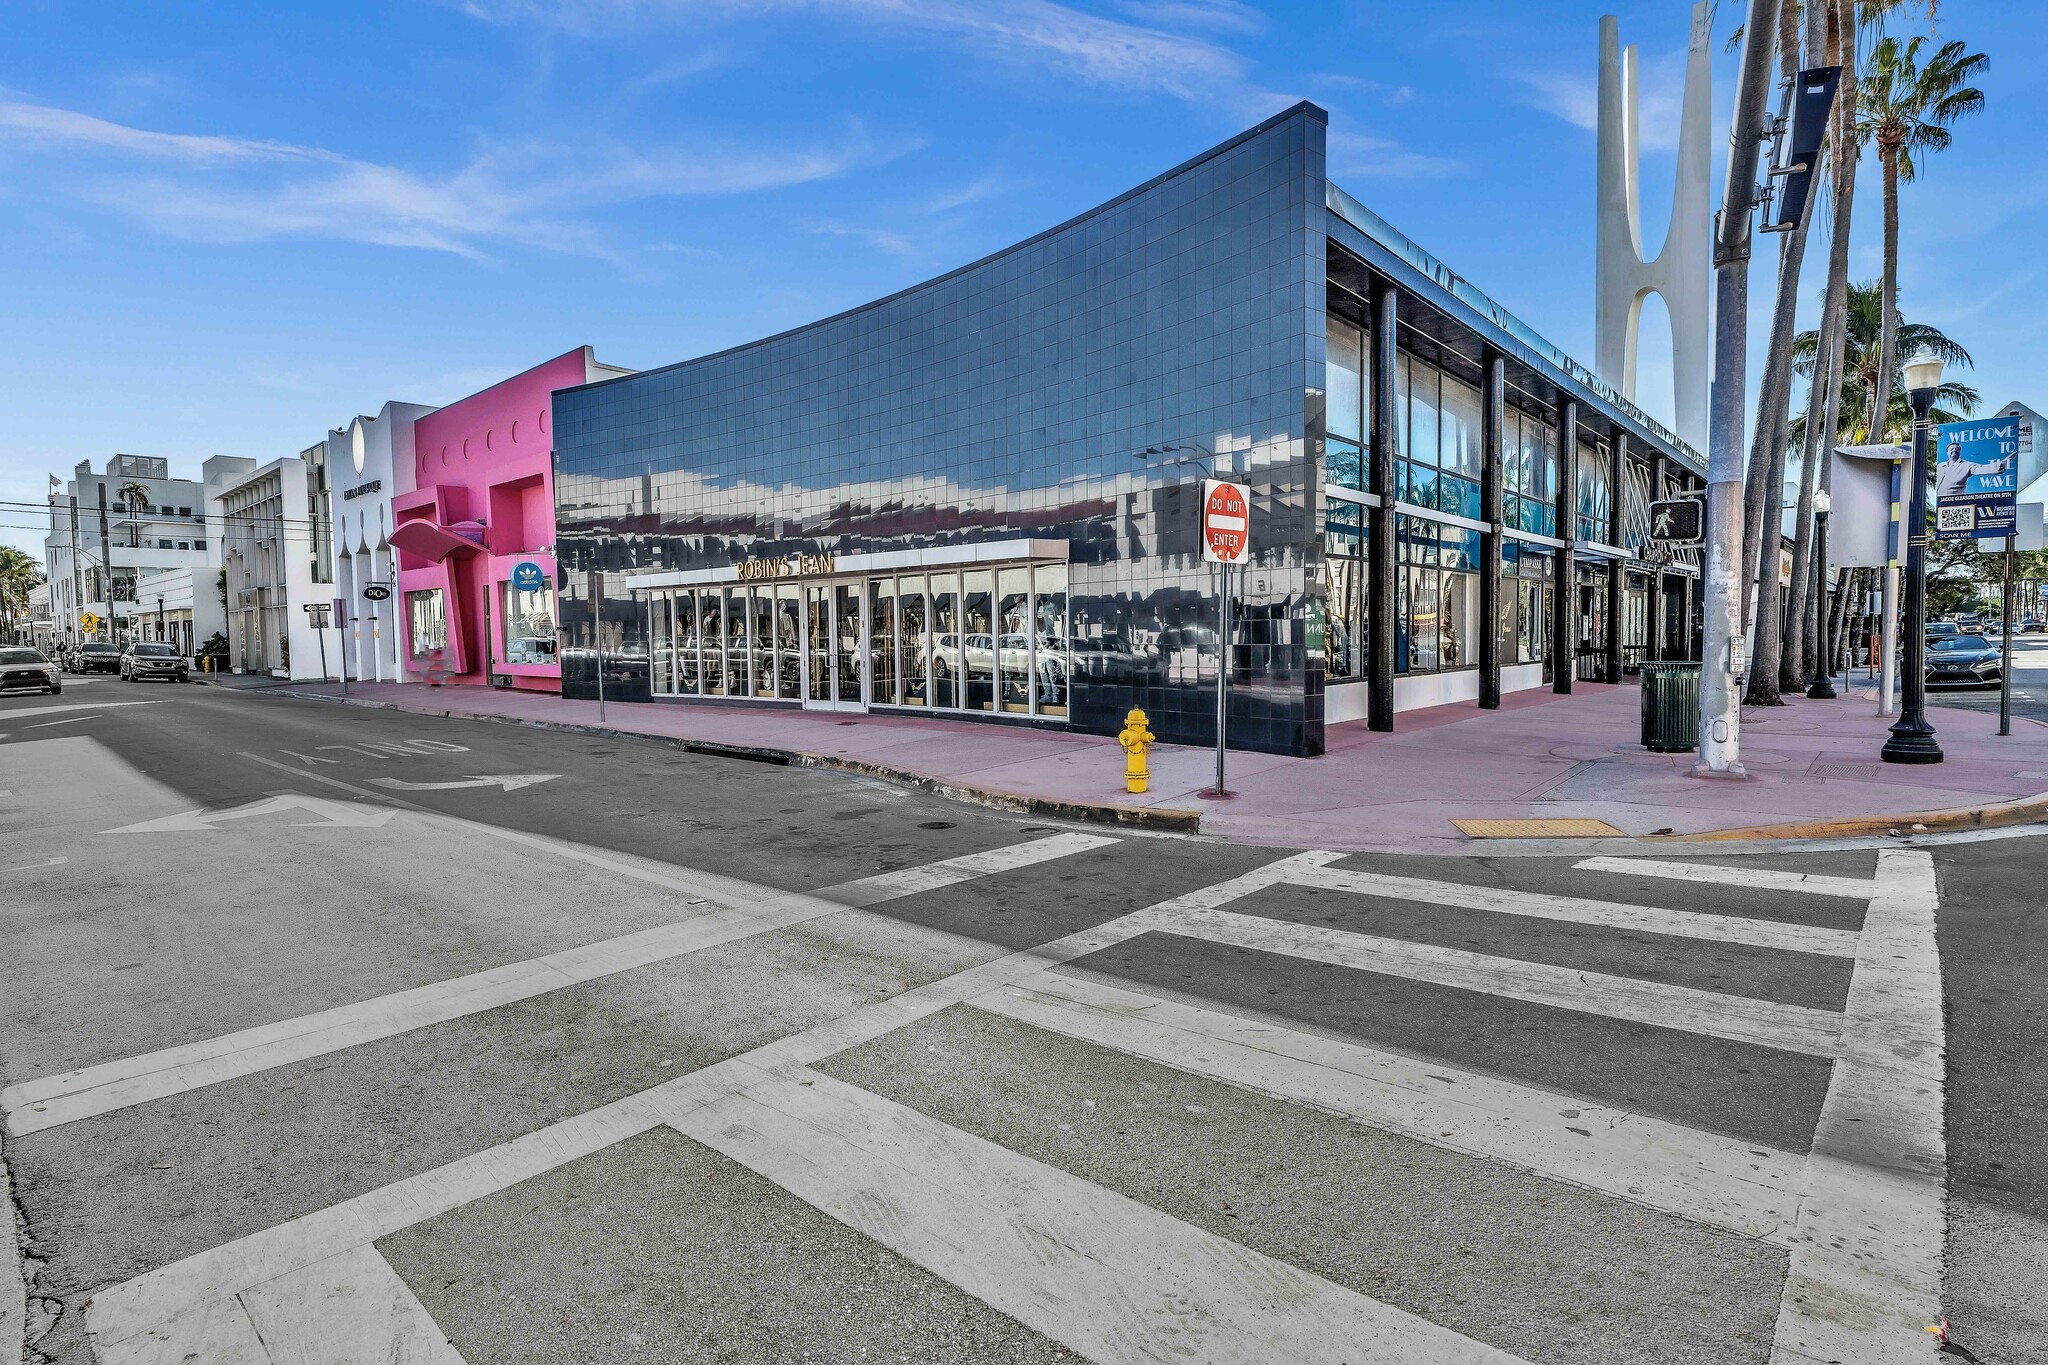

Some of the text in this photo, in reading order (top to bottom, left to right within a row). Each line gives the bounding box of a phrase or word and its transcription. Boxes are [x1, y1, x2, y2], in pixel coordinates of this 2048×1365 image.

[1948, 425, 2015, 443] WELCOME
[1999, 441, 2015, 454] TO
[1979, 474, 2015, 488] WAVE
[1212, 497, 1242, 513] DO NOT
[1213, 533, 1239, 547] ENTER
[736, 551, 833, 580] ROBIN'S JEAN
